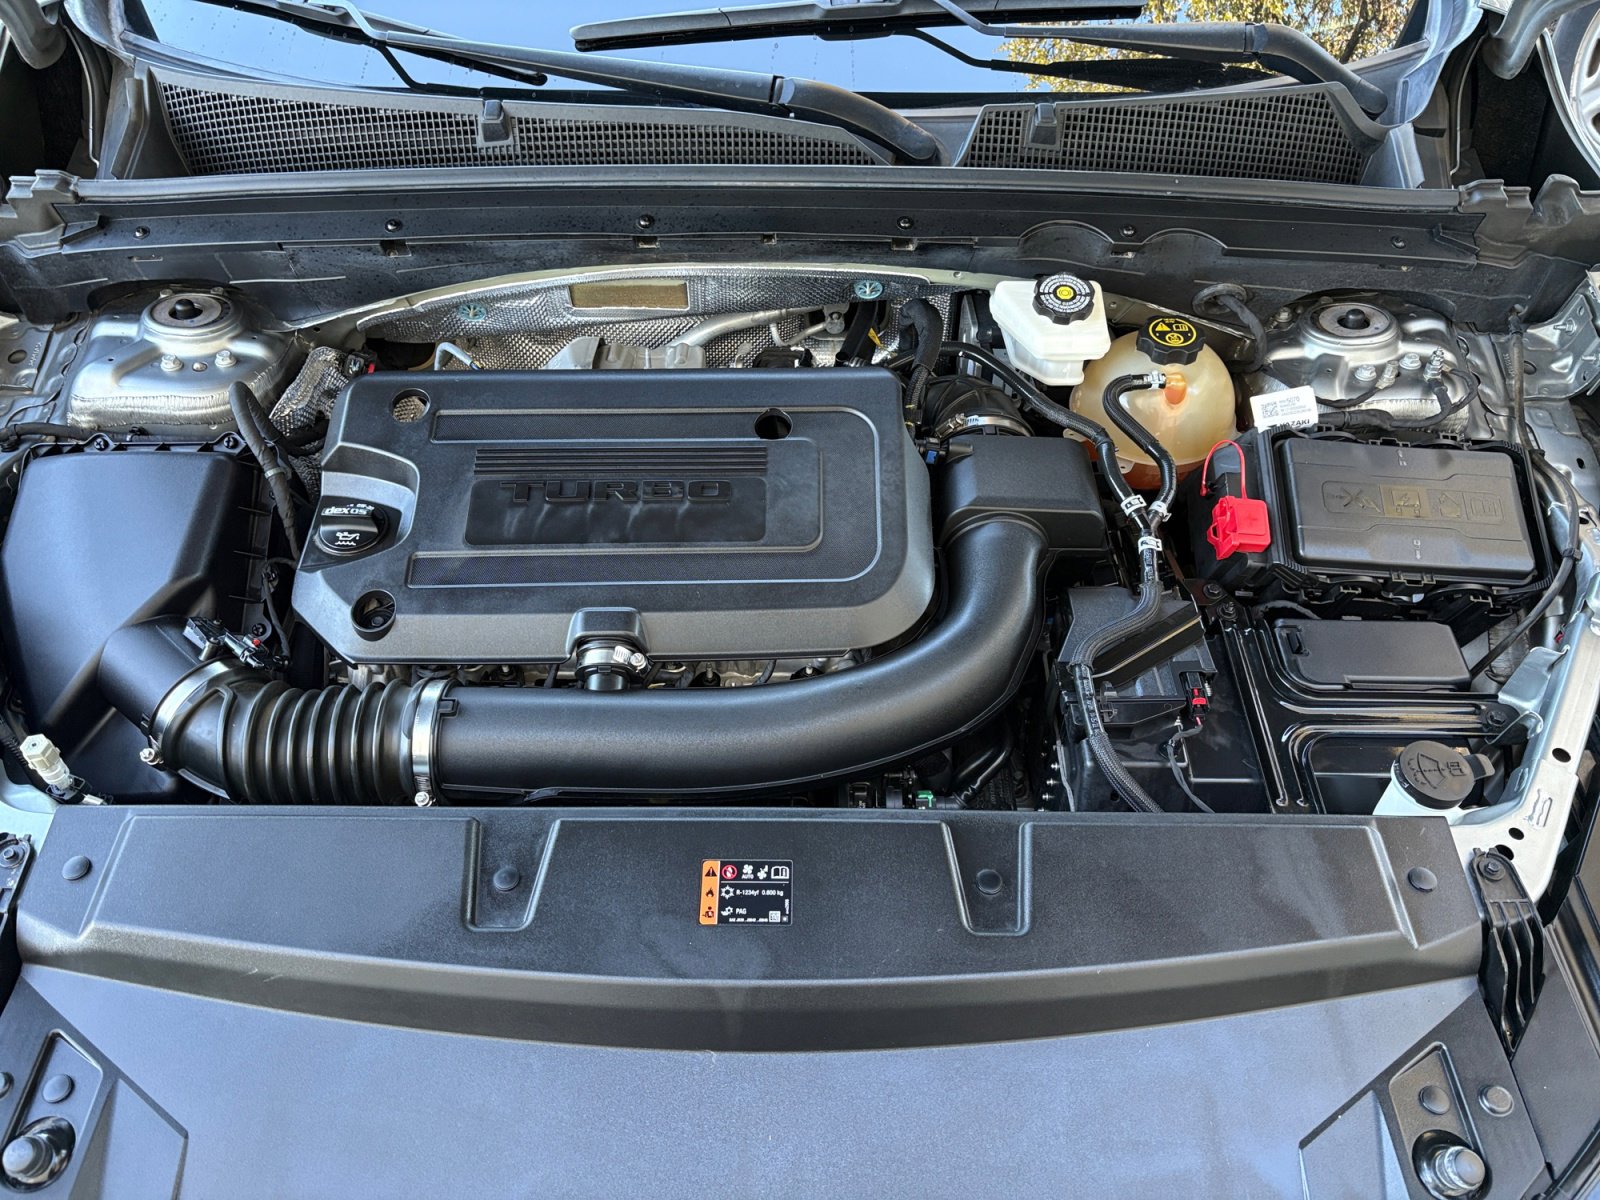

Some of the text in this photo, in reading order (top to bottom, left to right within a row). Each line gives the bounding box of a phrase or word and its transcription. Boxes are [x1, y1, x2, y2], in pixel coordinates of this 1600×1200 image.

[499, 479, 732, 505] TURBO
[324, 506, 368, 515] dexos
[736, 889, 760, 897] R-1234yf
[777, 889, 784, 897] kg
